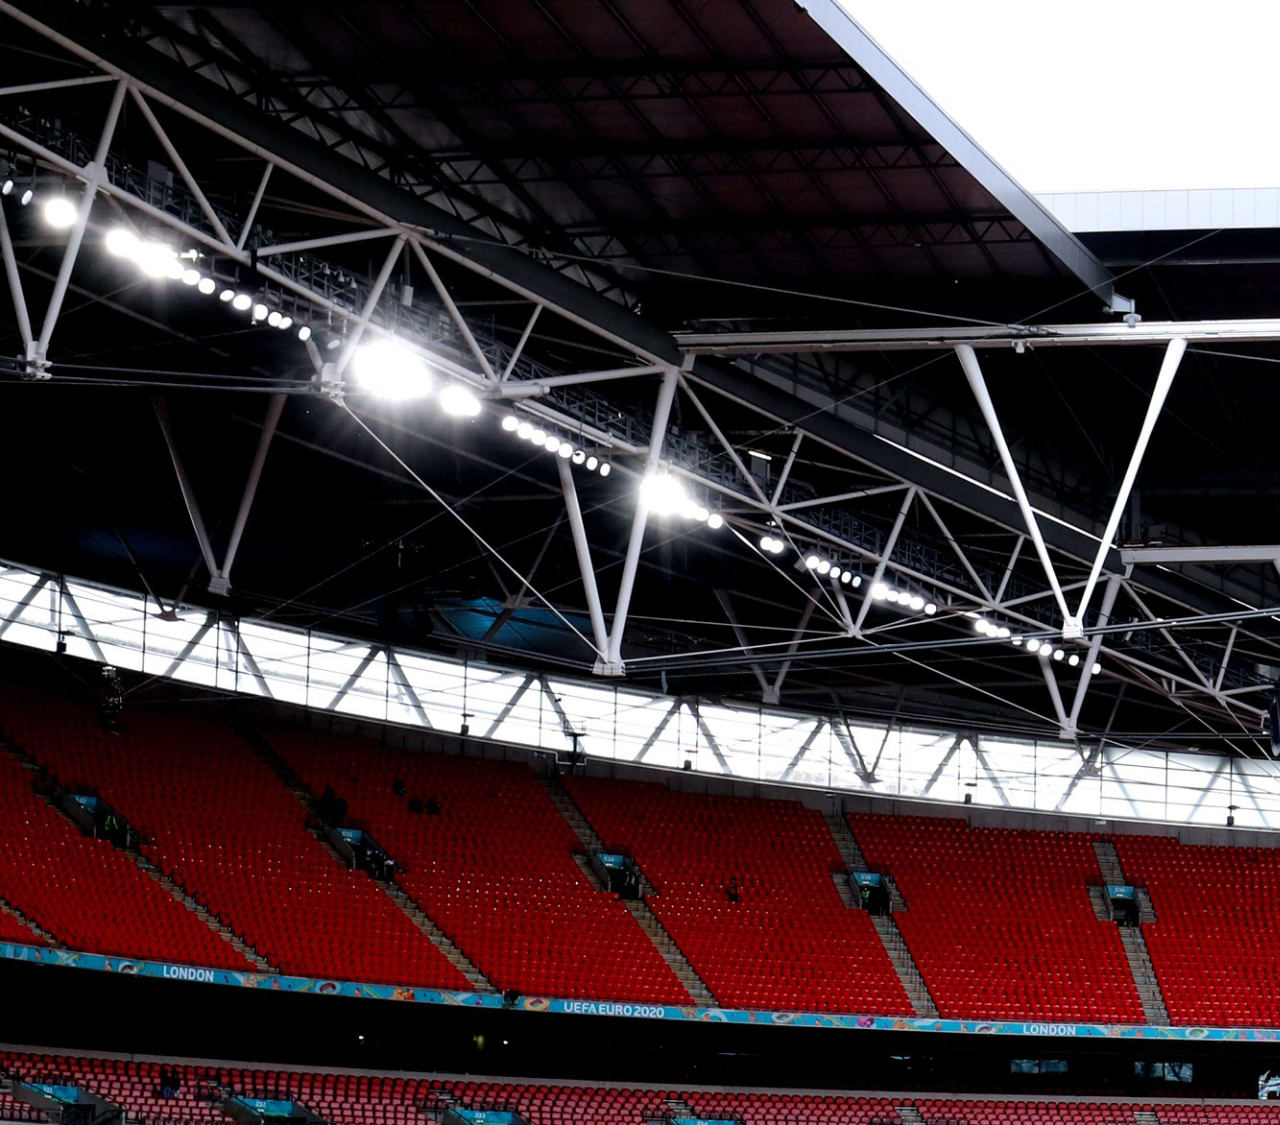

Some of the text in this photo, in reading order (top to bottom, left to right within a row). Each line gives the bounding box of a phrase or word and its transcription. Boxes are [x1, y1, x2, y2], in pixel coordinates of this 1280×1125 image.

[163, 965, 214, 983] LONDON
[563, 1001, 665, 1018] UEFA EURO 2020
[1022, 1024, 1076, 1036] LONDON
